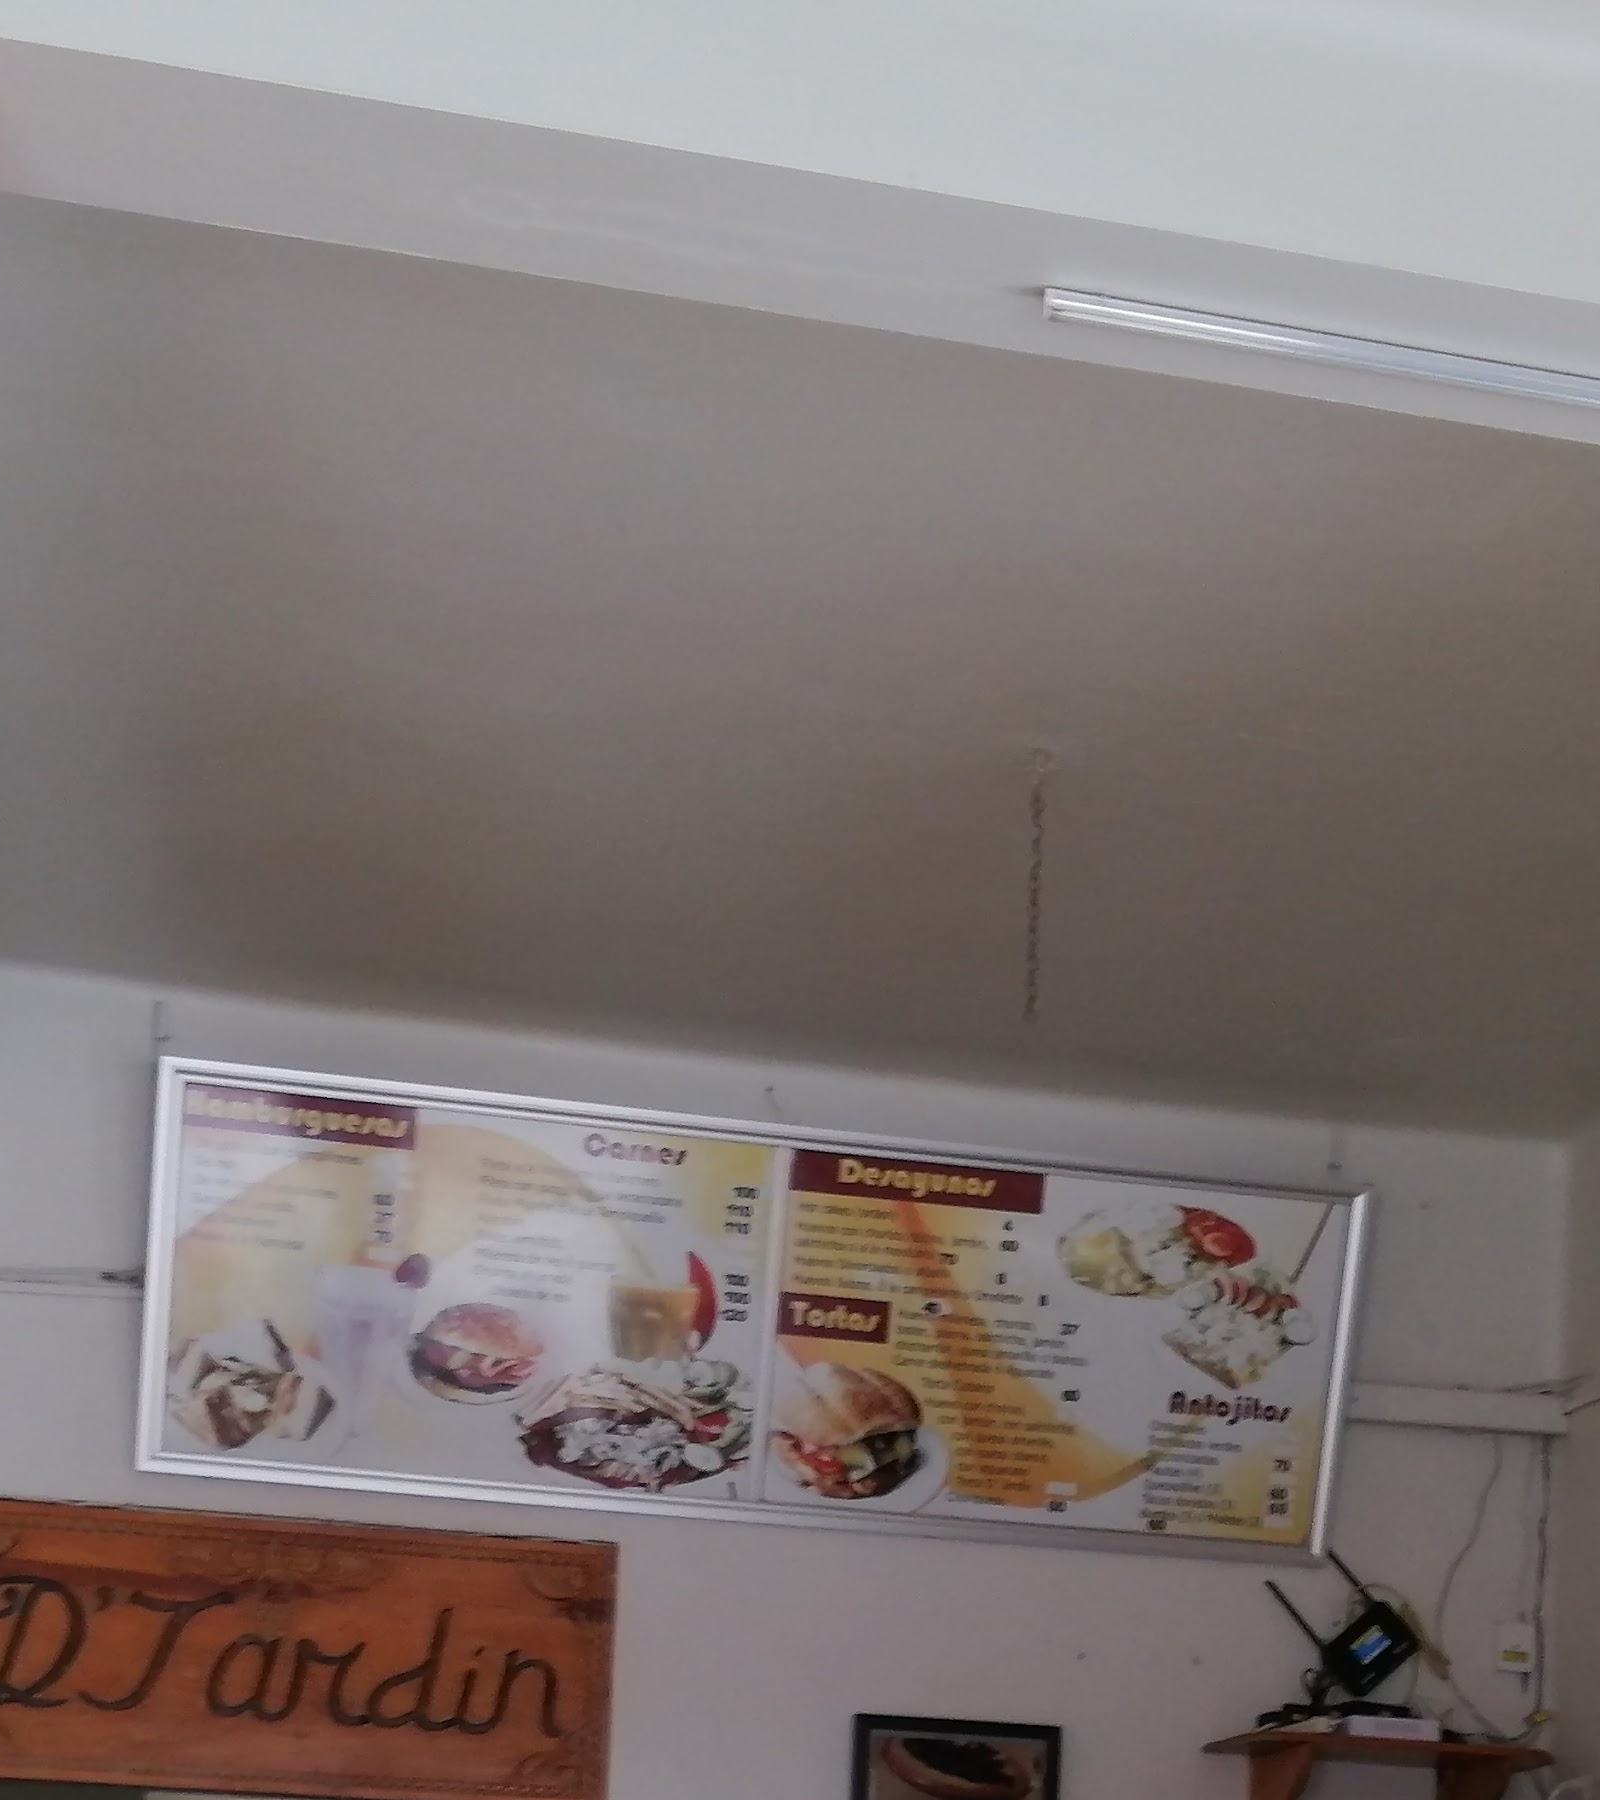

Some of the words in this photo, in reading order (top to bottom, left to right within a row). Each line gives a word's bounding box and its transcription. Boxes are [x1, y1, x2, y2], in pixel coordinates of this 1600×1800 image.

[583, 1133, 690, 1166] Carnes
[836, 1158, 997, 1198] Desayunos
[788, 1300, 882, 1333] Tortas
[1168, 1390, 1292, 1425] Antojitos
